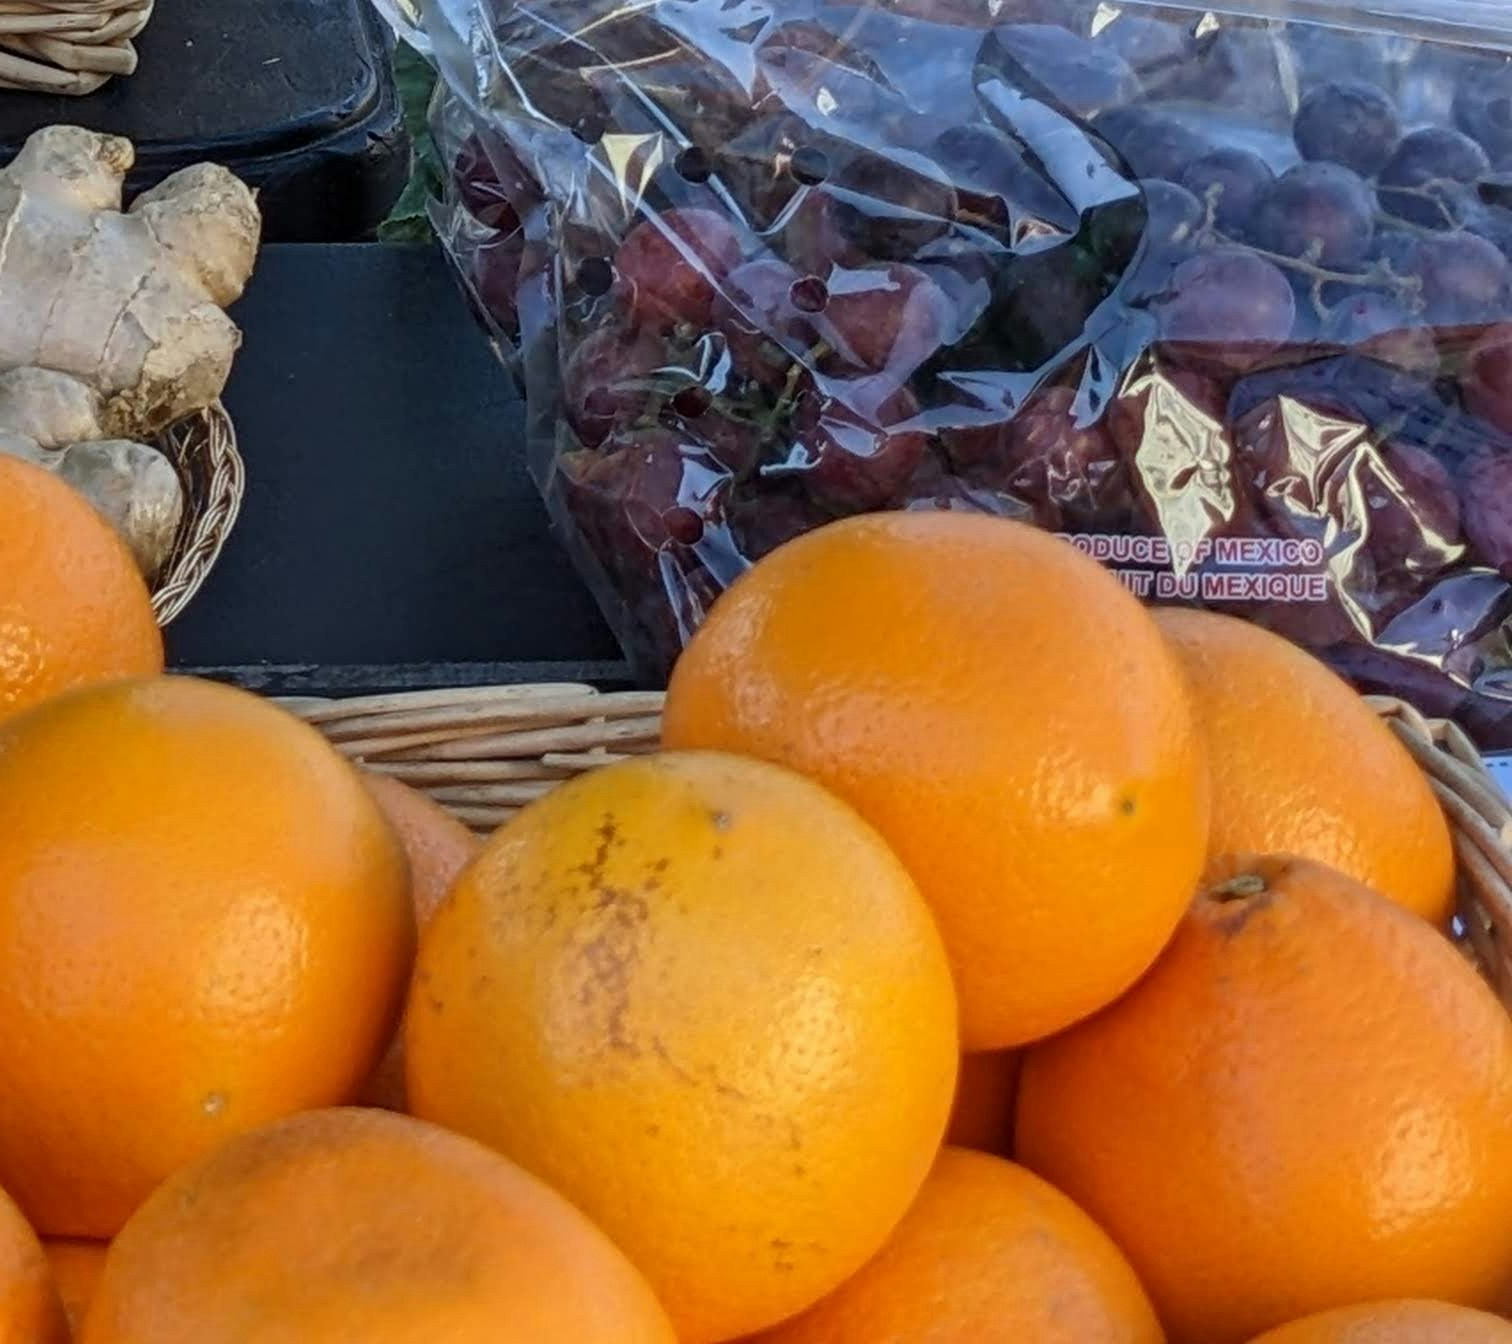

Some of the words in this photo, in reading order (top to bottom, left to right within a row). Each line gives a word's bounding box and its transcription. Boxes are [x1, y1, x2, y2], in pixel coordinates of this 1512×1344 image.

[1062, 536, 1167, 560] ODUCE
[1218, 540, 1321, 562] MEXICO
[1160, 575, 1196, 597] DU
[1204, 576, 1325, 600] MEXIQUE
